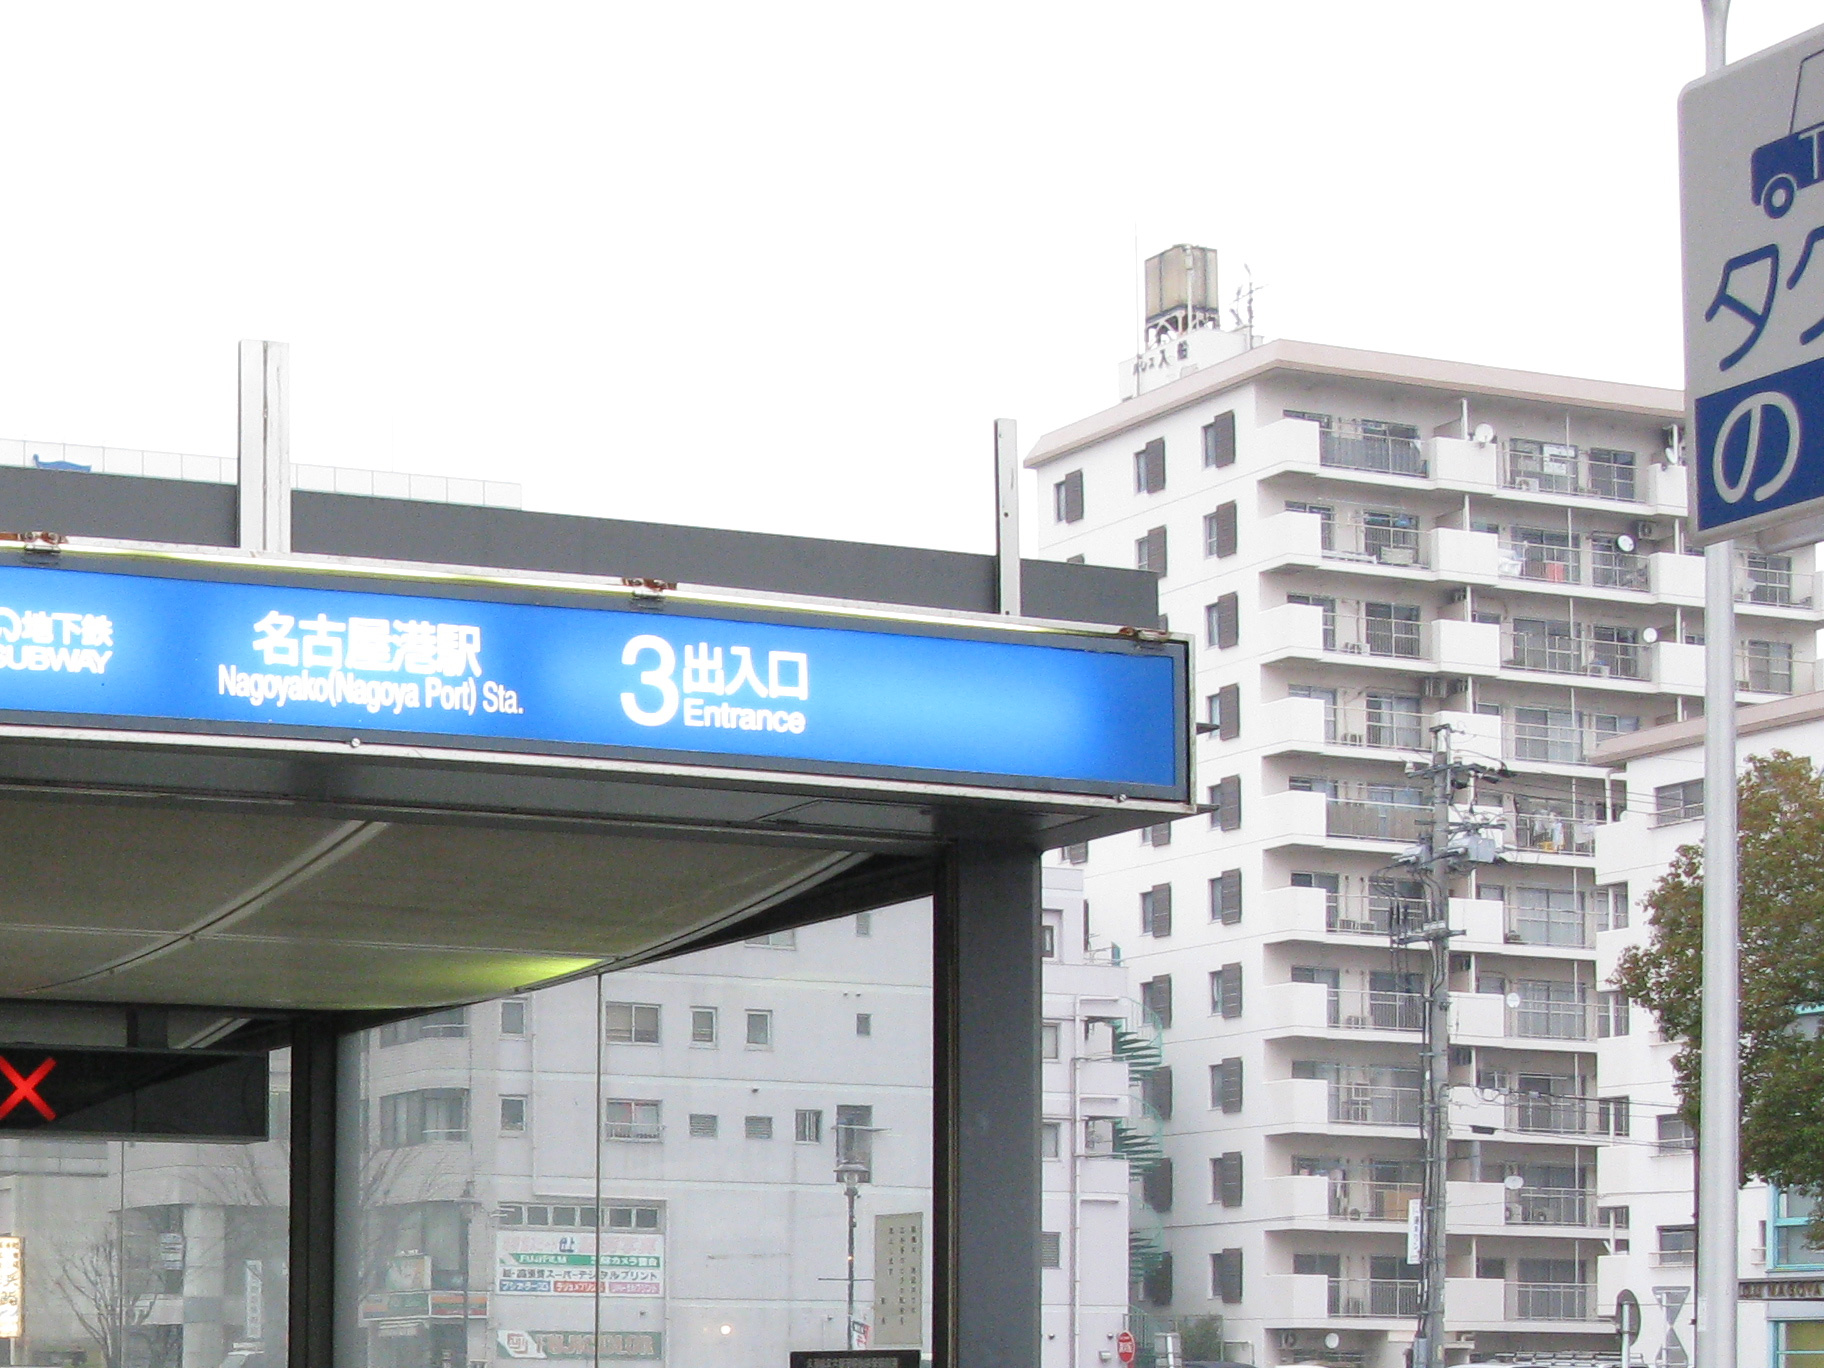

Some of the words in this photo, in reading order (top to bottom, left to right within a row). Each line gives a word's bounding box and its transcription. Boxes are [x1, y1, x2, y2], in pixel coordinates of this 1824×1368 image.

[21, 610, 114, 647] 地下鉄
[252, 609, 483, 678] 名古屋港駅
[424, 676, 478, 716] Port)
[482, 681, 526, 714] Sta.
[620, 633, 680, 728] 3
[682, 641, 809, 701] 出入口
[683, 697, 807, 735] Entrance
